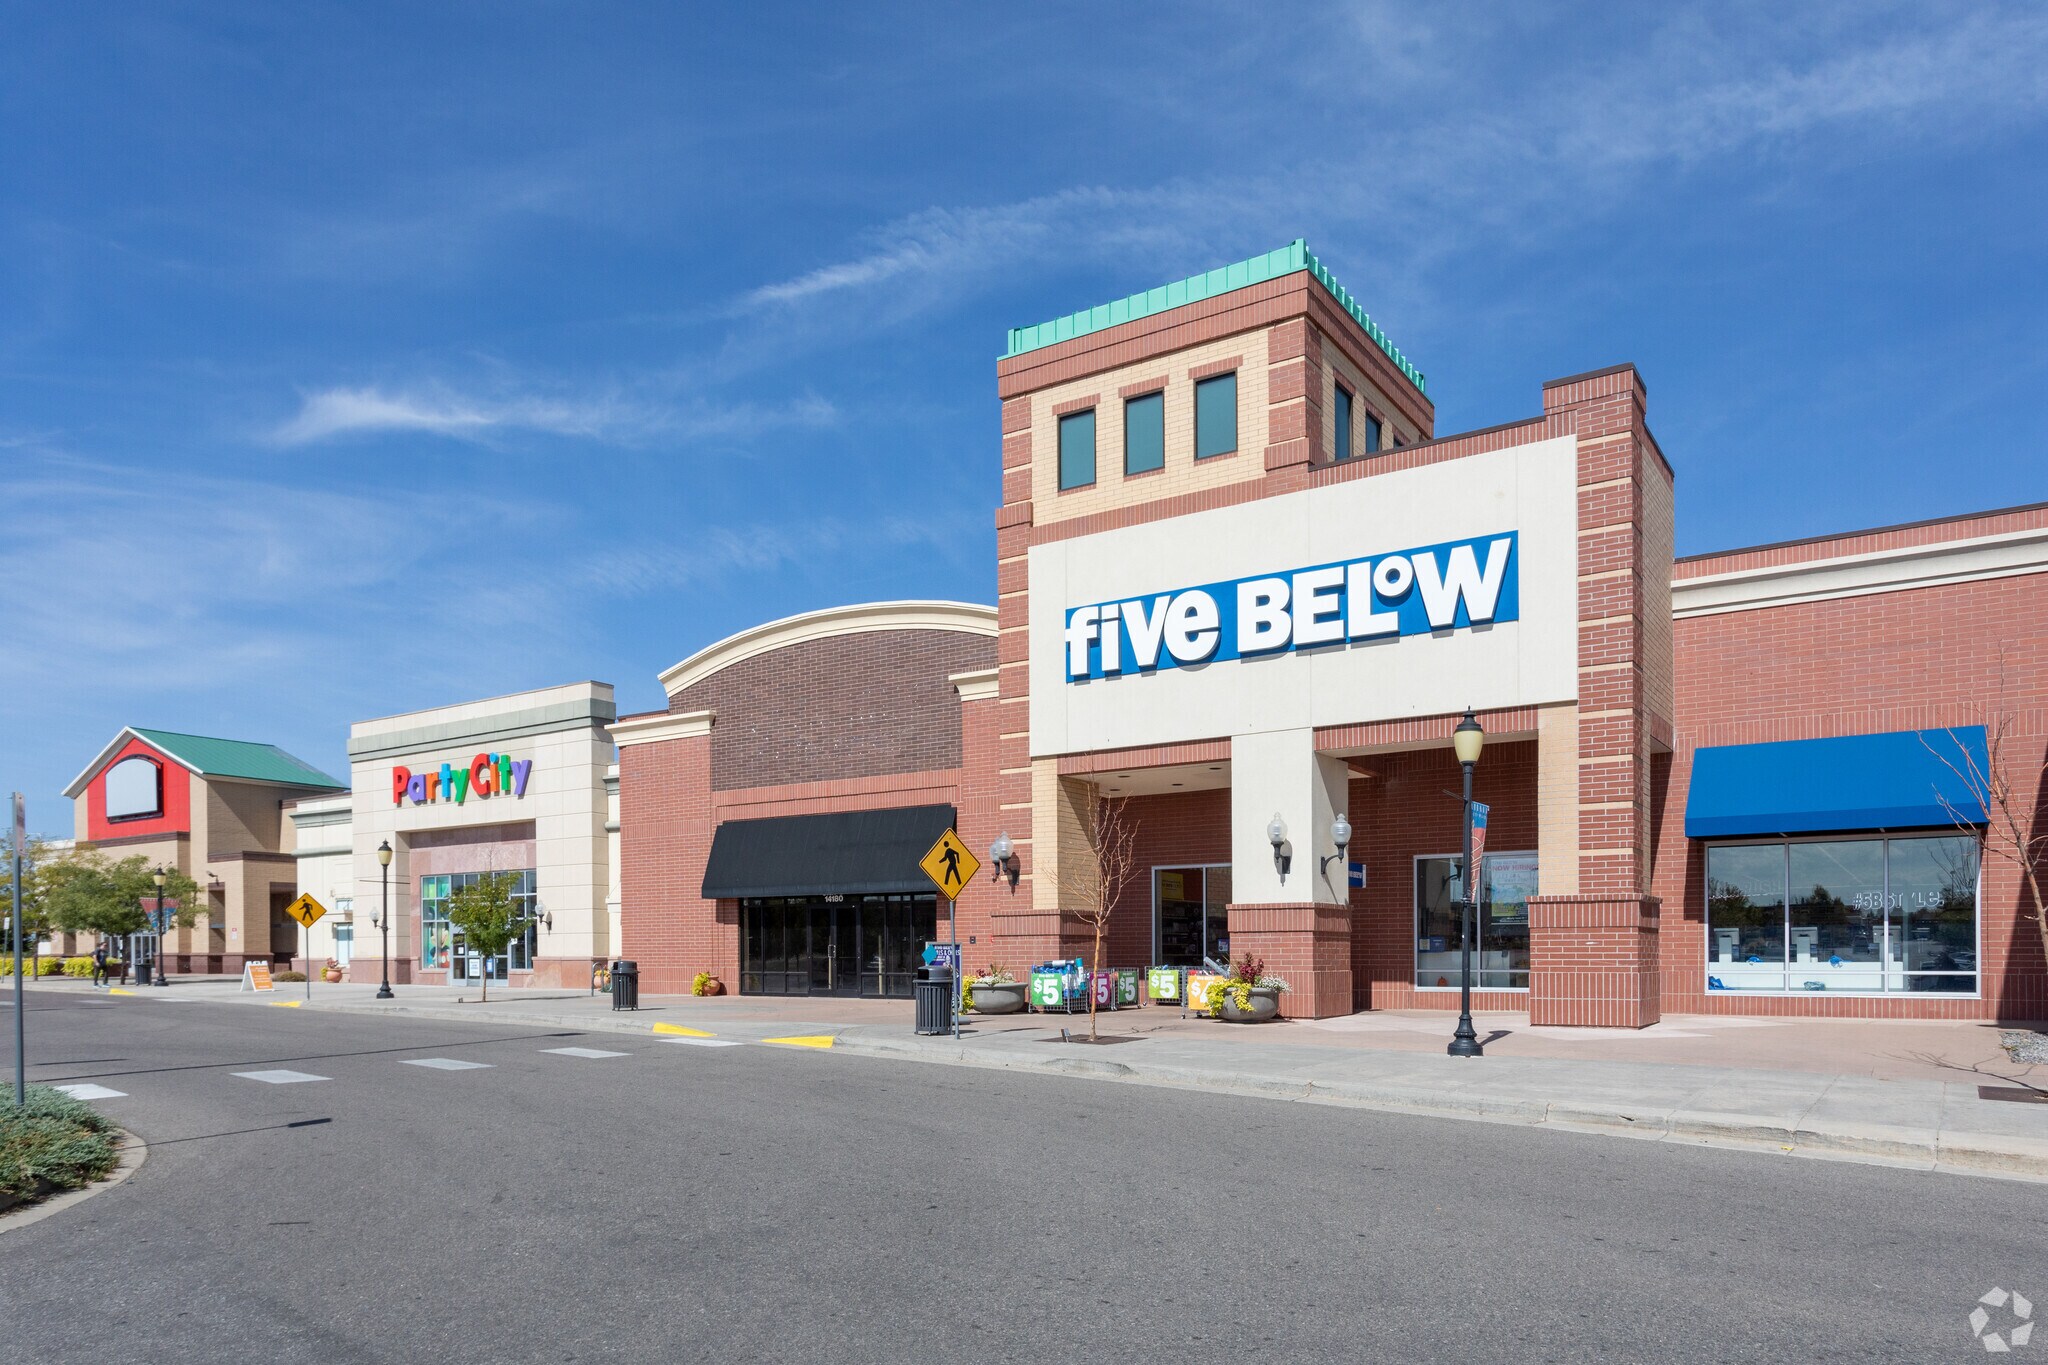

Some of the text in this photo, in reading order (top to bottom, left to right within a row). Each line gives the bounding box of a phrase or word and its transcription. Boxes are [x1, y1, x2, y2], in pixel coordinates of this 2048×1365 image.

[1065, 537, 1511, 675] five BELOW
[1034, 978, 1059, 1005] $5
[1092, 978, 1110, 1003] 5
[1120, 977, 1135, 1001] $5
[1151, 974, 1175, 998] $5
